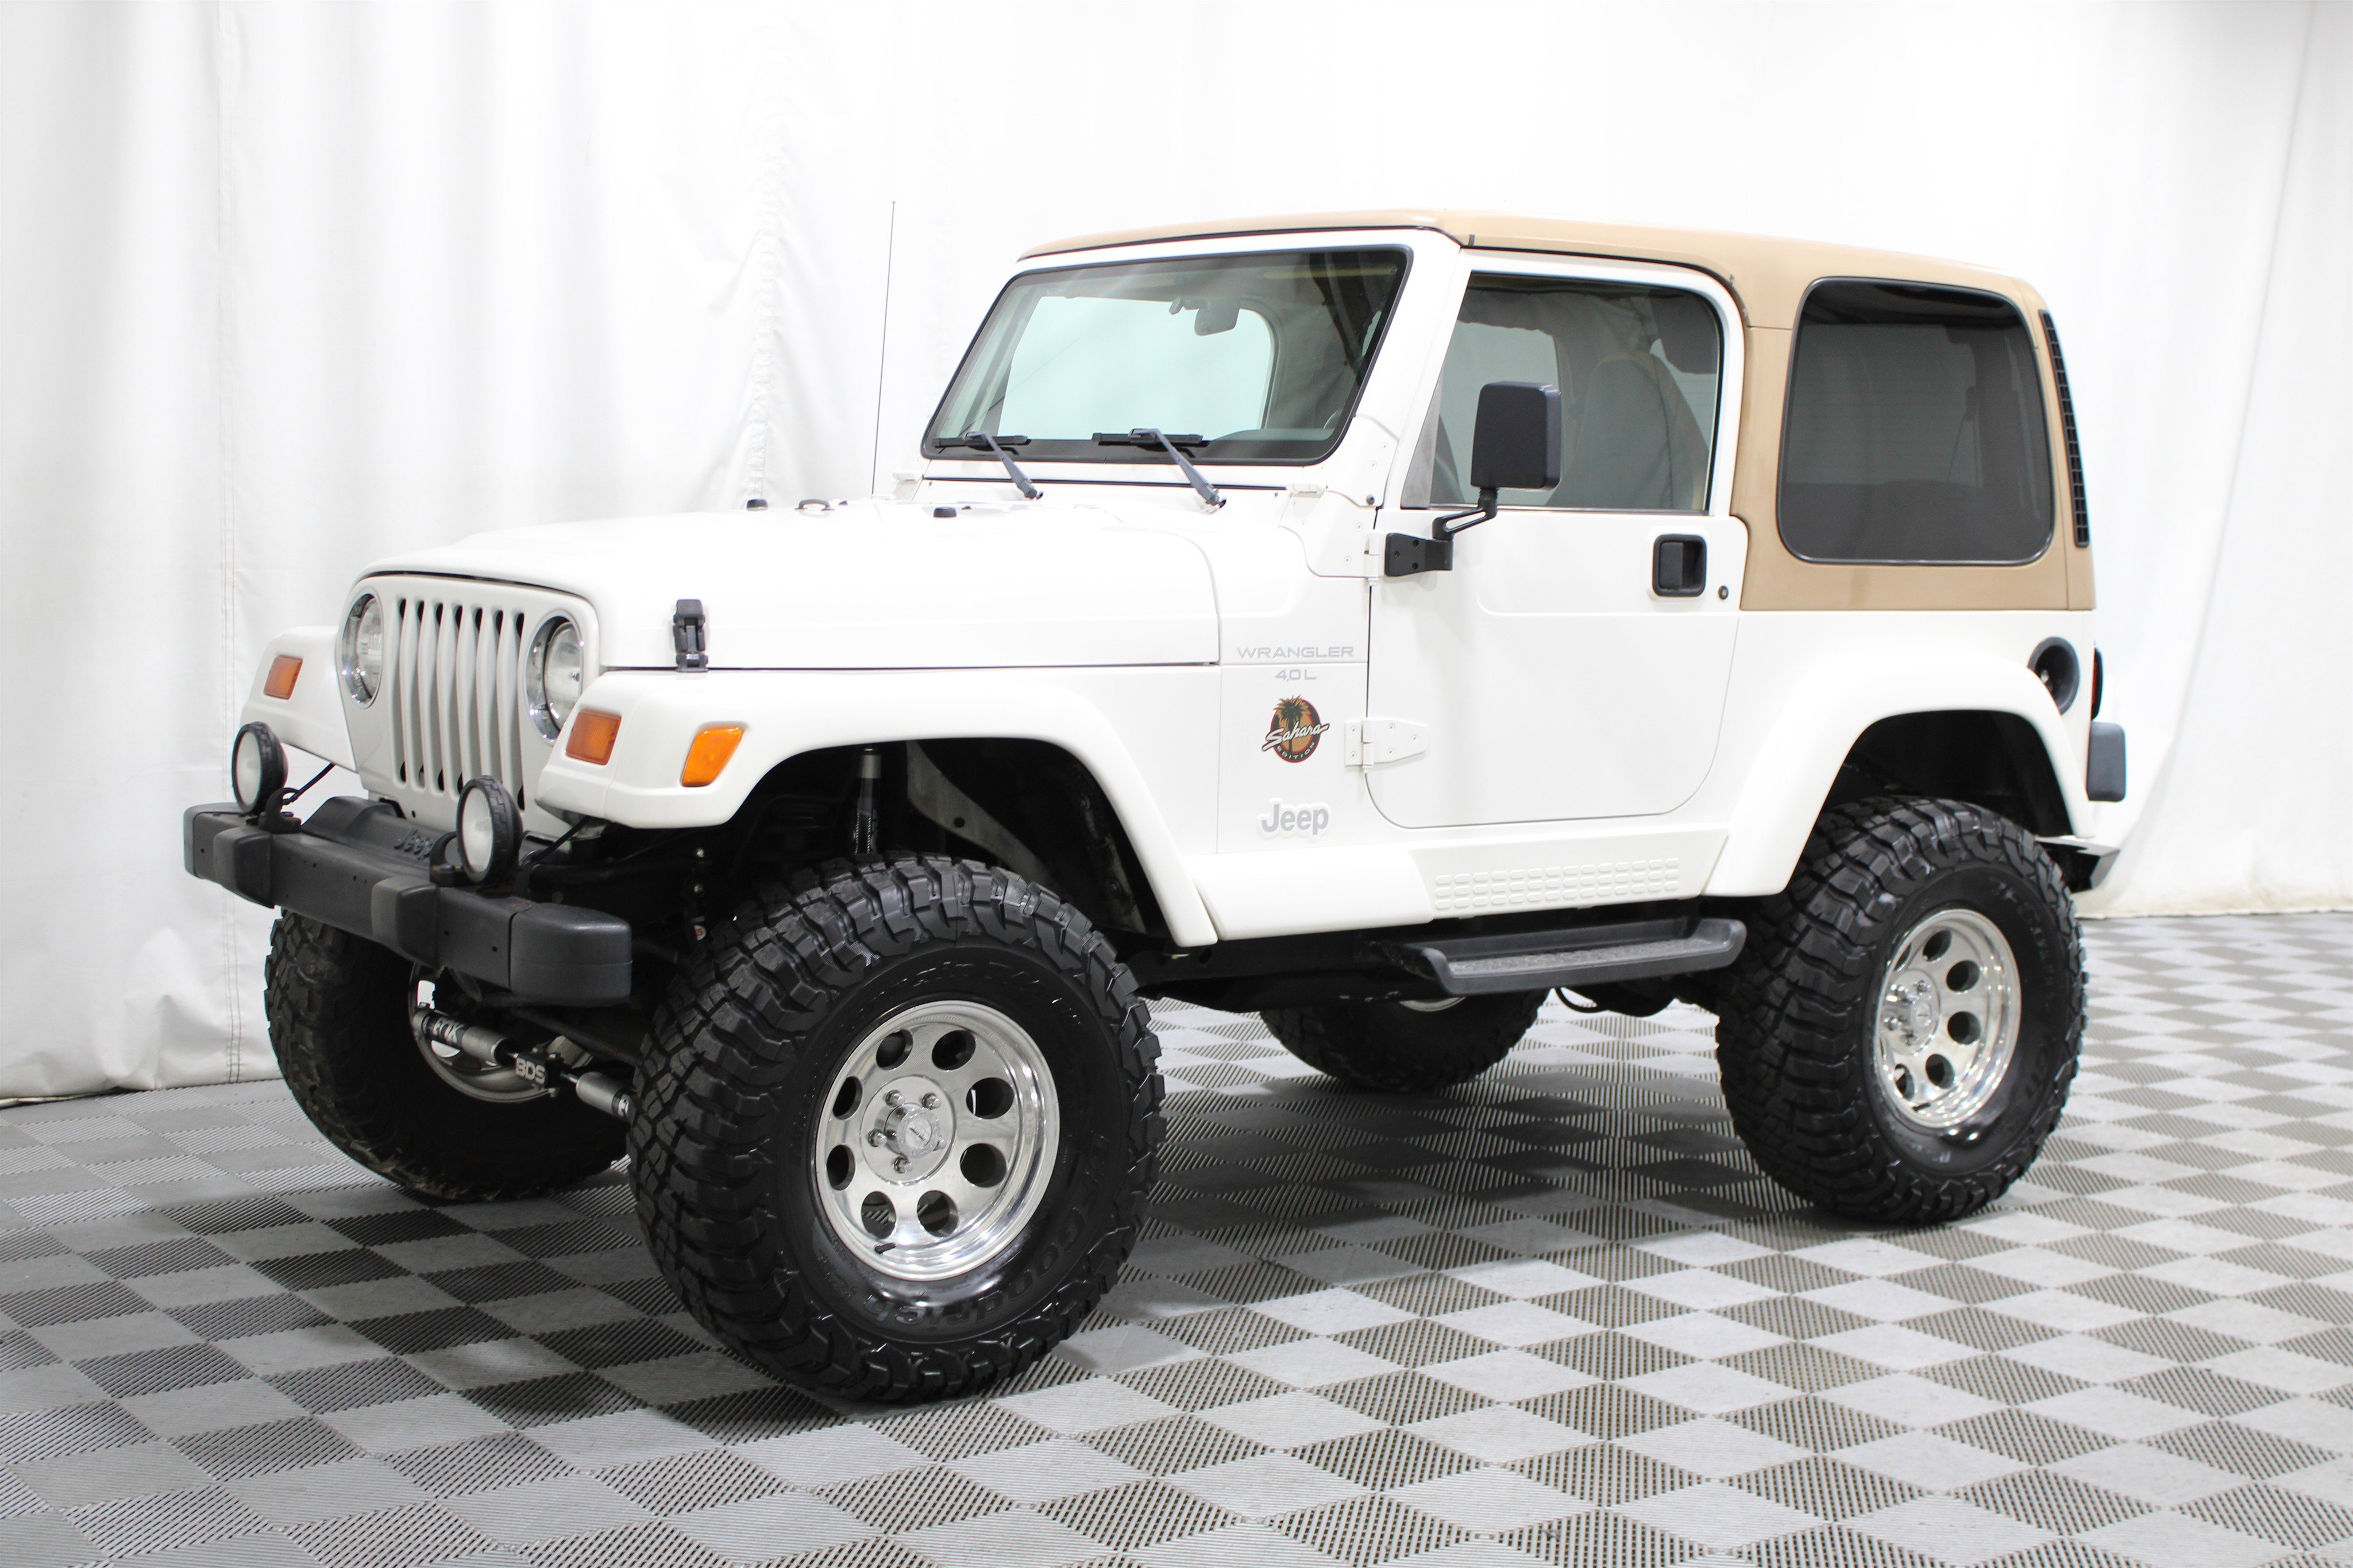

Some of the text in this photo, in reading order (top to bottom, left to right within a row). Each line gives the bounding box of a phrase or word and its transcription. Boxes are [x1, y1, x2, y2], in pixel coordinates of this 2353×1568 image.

[1236, 646, 1355, 659] WRANGLER
[1262, 720, 1330, 752] Sahara
[1276, 741, 1315, 760] EDITION
[1260, 803, 1329, 836] Jeep
[394, 827, 434, 860] Jeep
[432, 1016, 465, 1044] FOX
[515, 1056, 546, 1085] BDS
